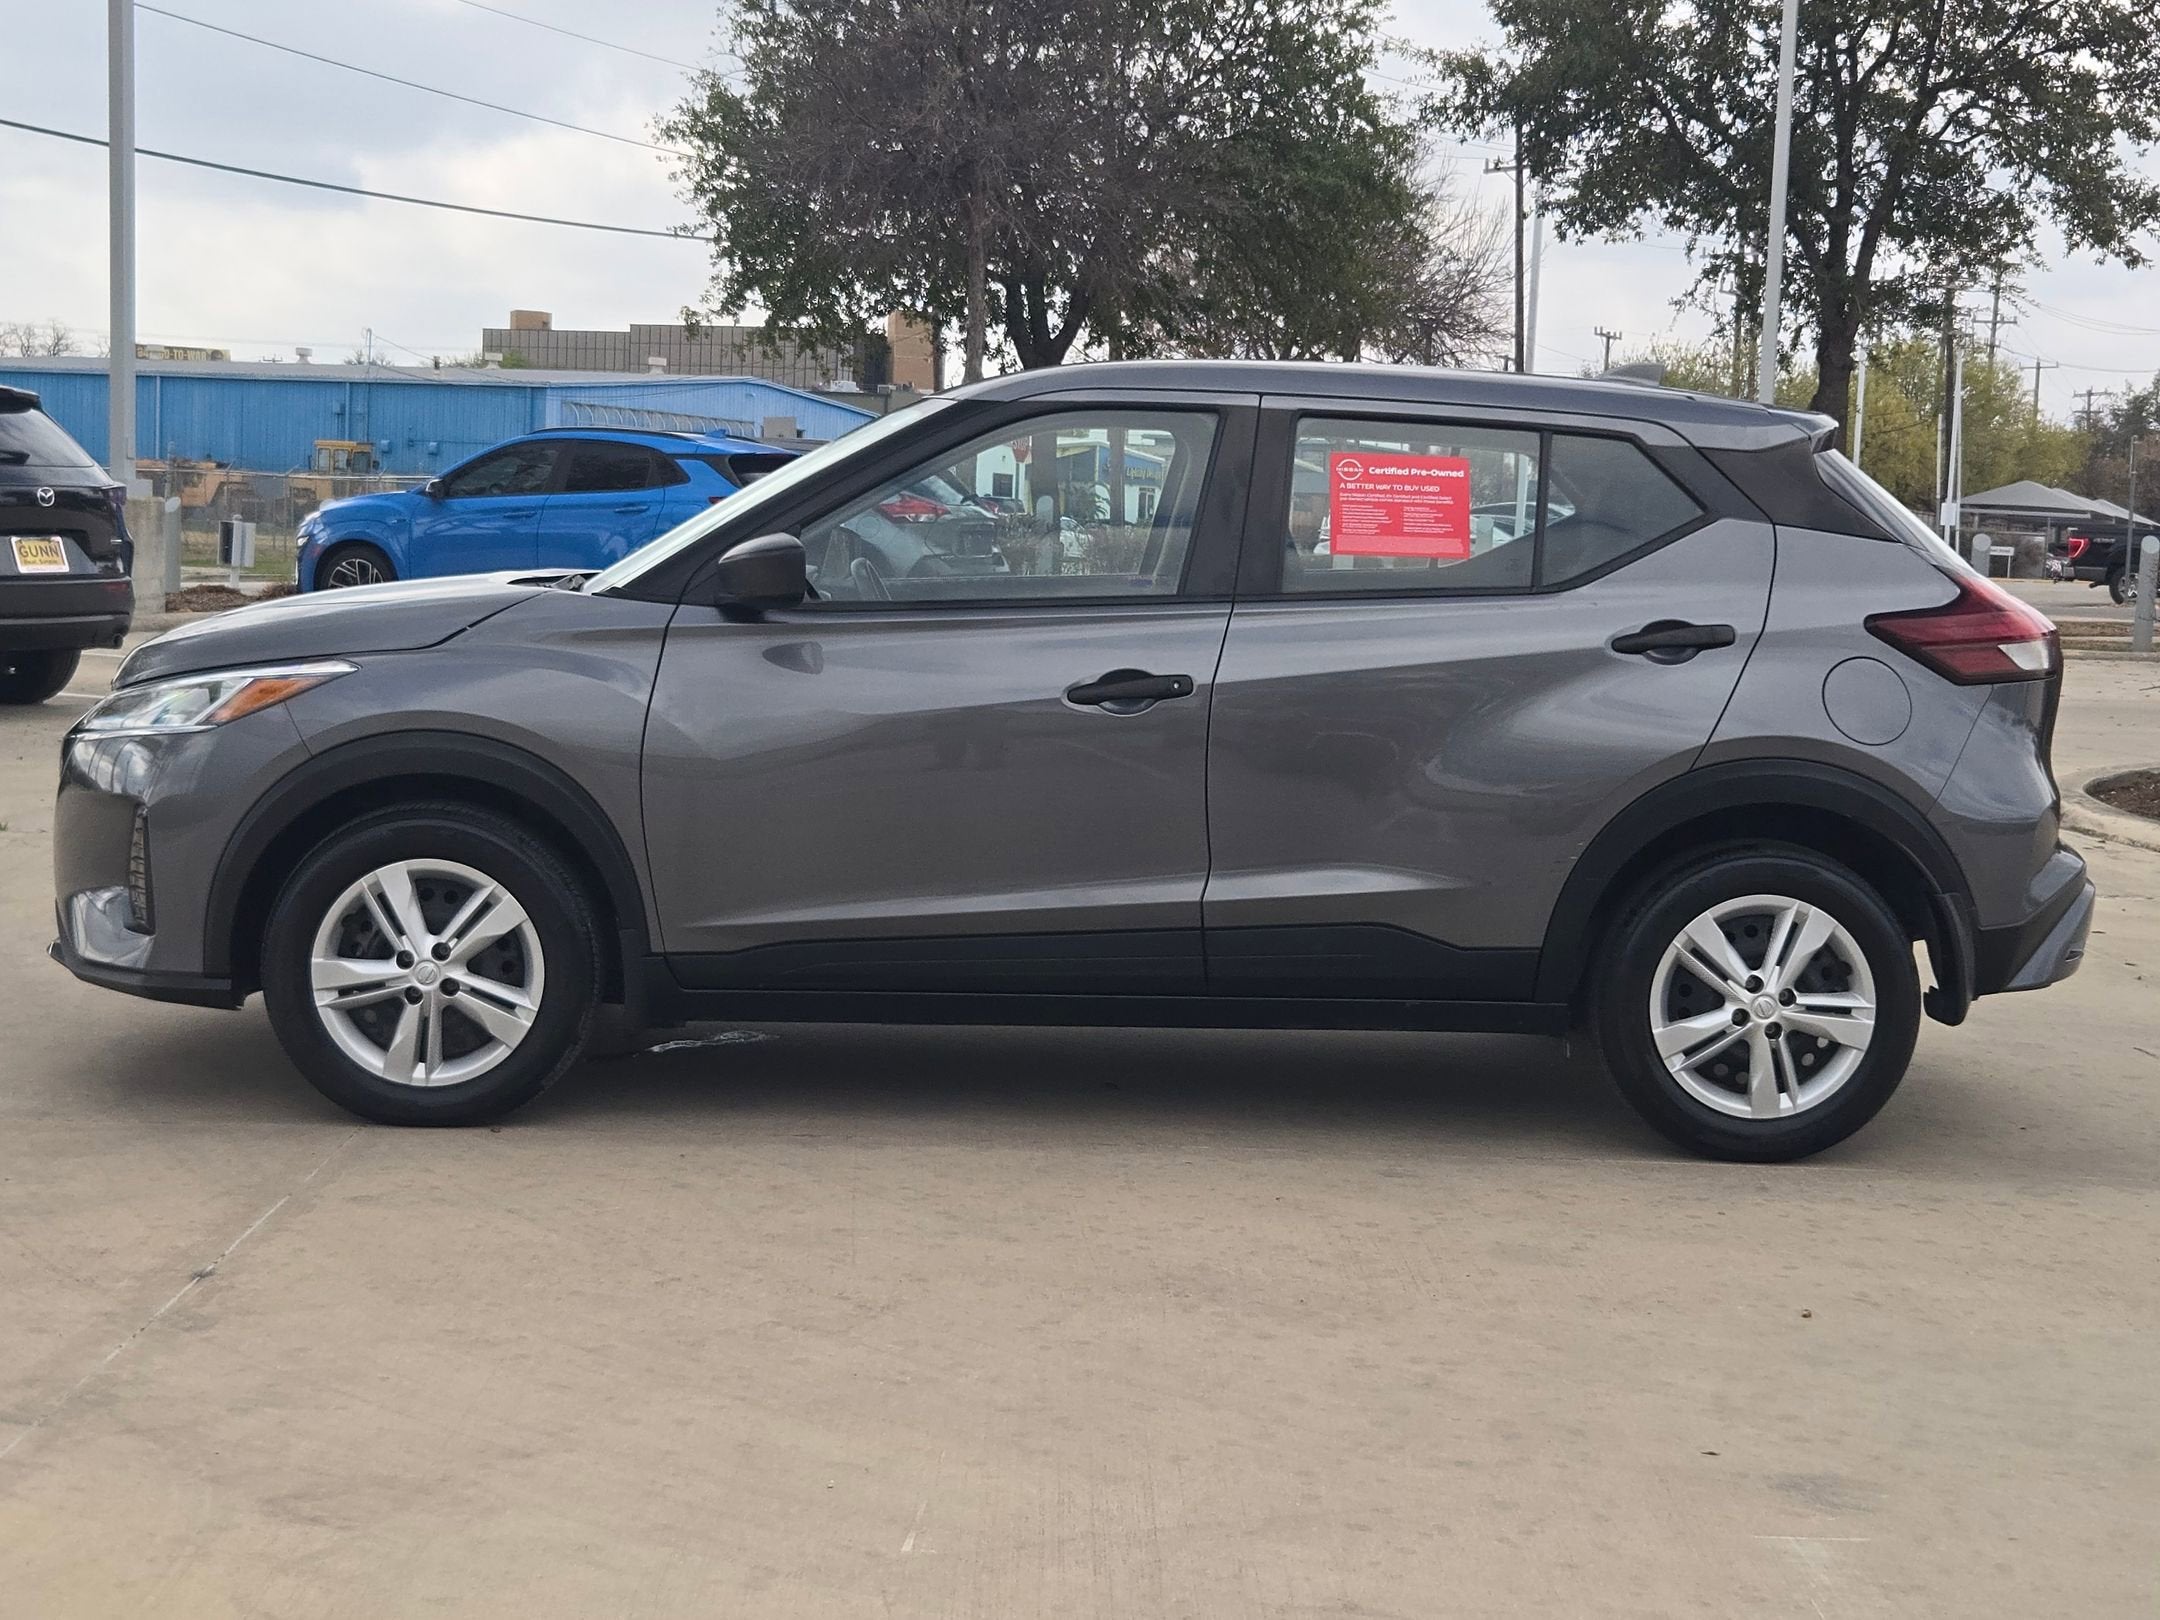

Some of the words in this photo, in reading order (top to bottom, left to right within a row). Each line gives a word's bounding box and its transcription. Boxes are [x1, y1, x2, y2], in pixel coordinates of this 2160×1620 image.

[1012, 438, 1028, 450] STOP
[1369, 466, 1409, 475] Certified
[1411, 468, 1465, 478] Pre-Owned
[19, 545, 59, 558] GUNN
